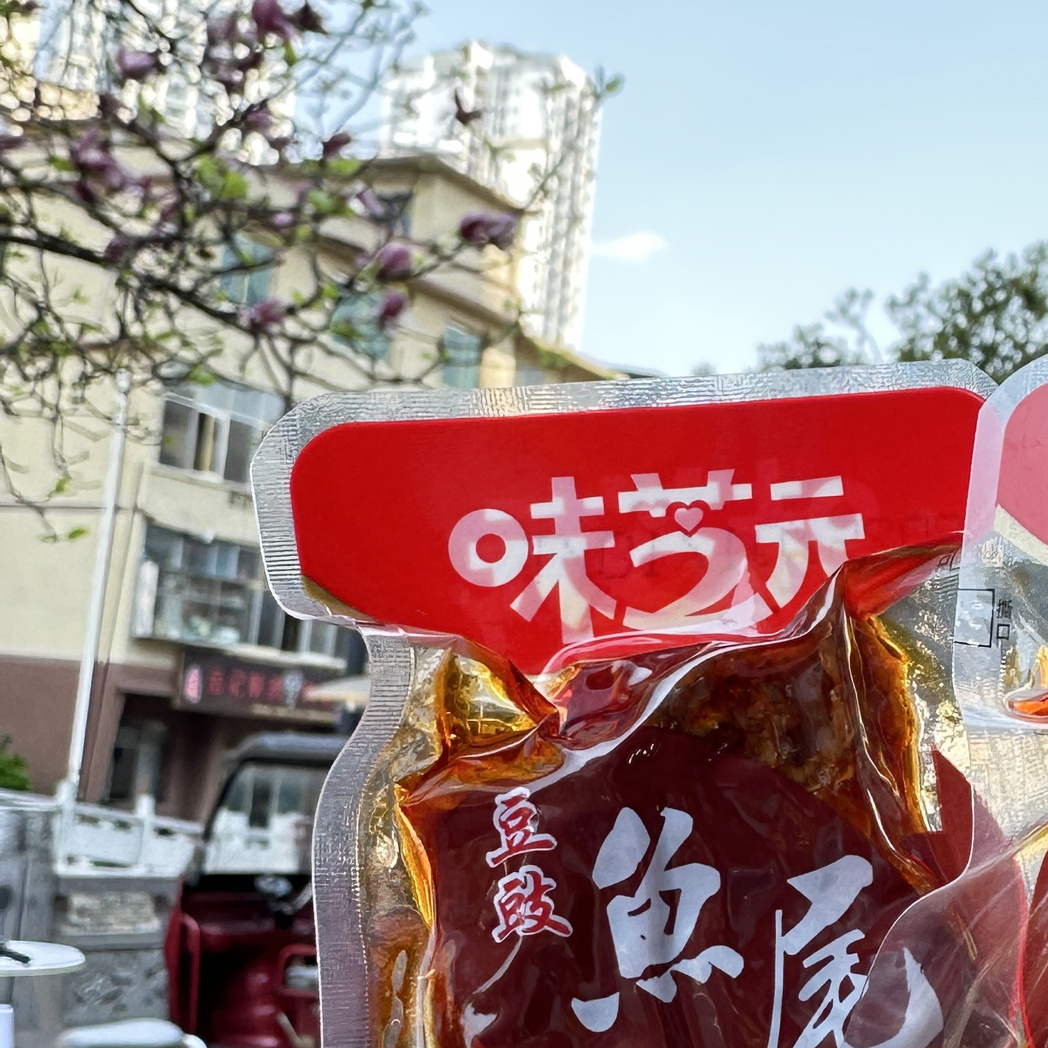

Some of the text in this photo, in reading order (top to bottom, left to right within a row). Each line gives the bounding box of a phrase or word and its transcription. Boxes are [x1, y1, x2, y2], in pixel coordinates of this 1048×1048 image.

[448, 469, 866, 645] 味芝元
[486, 786, 573, 943] 豆豉
